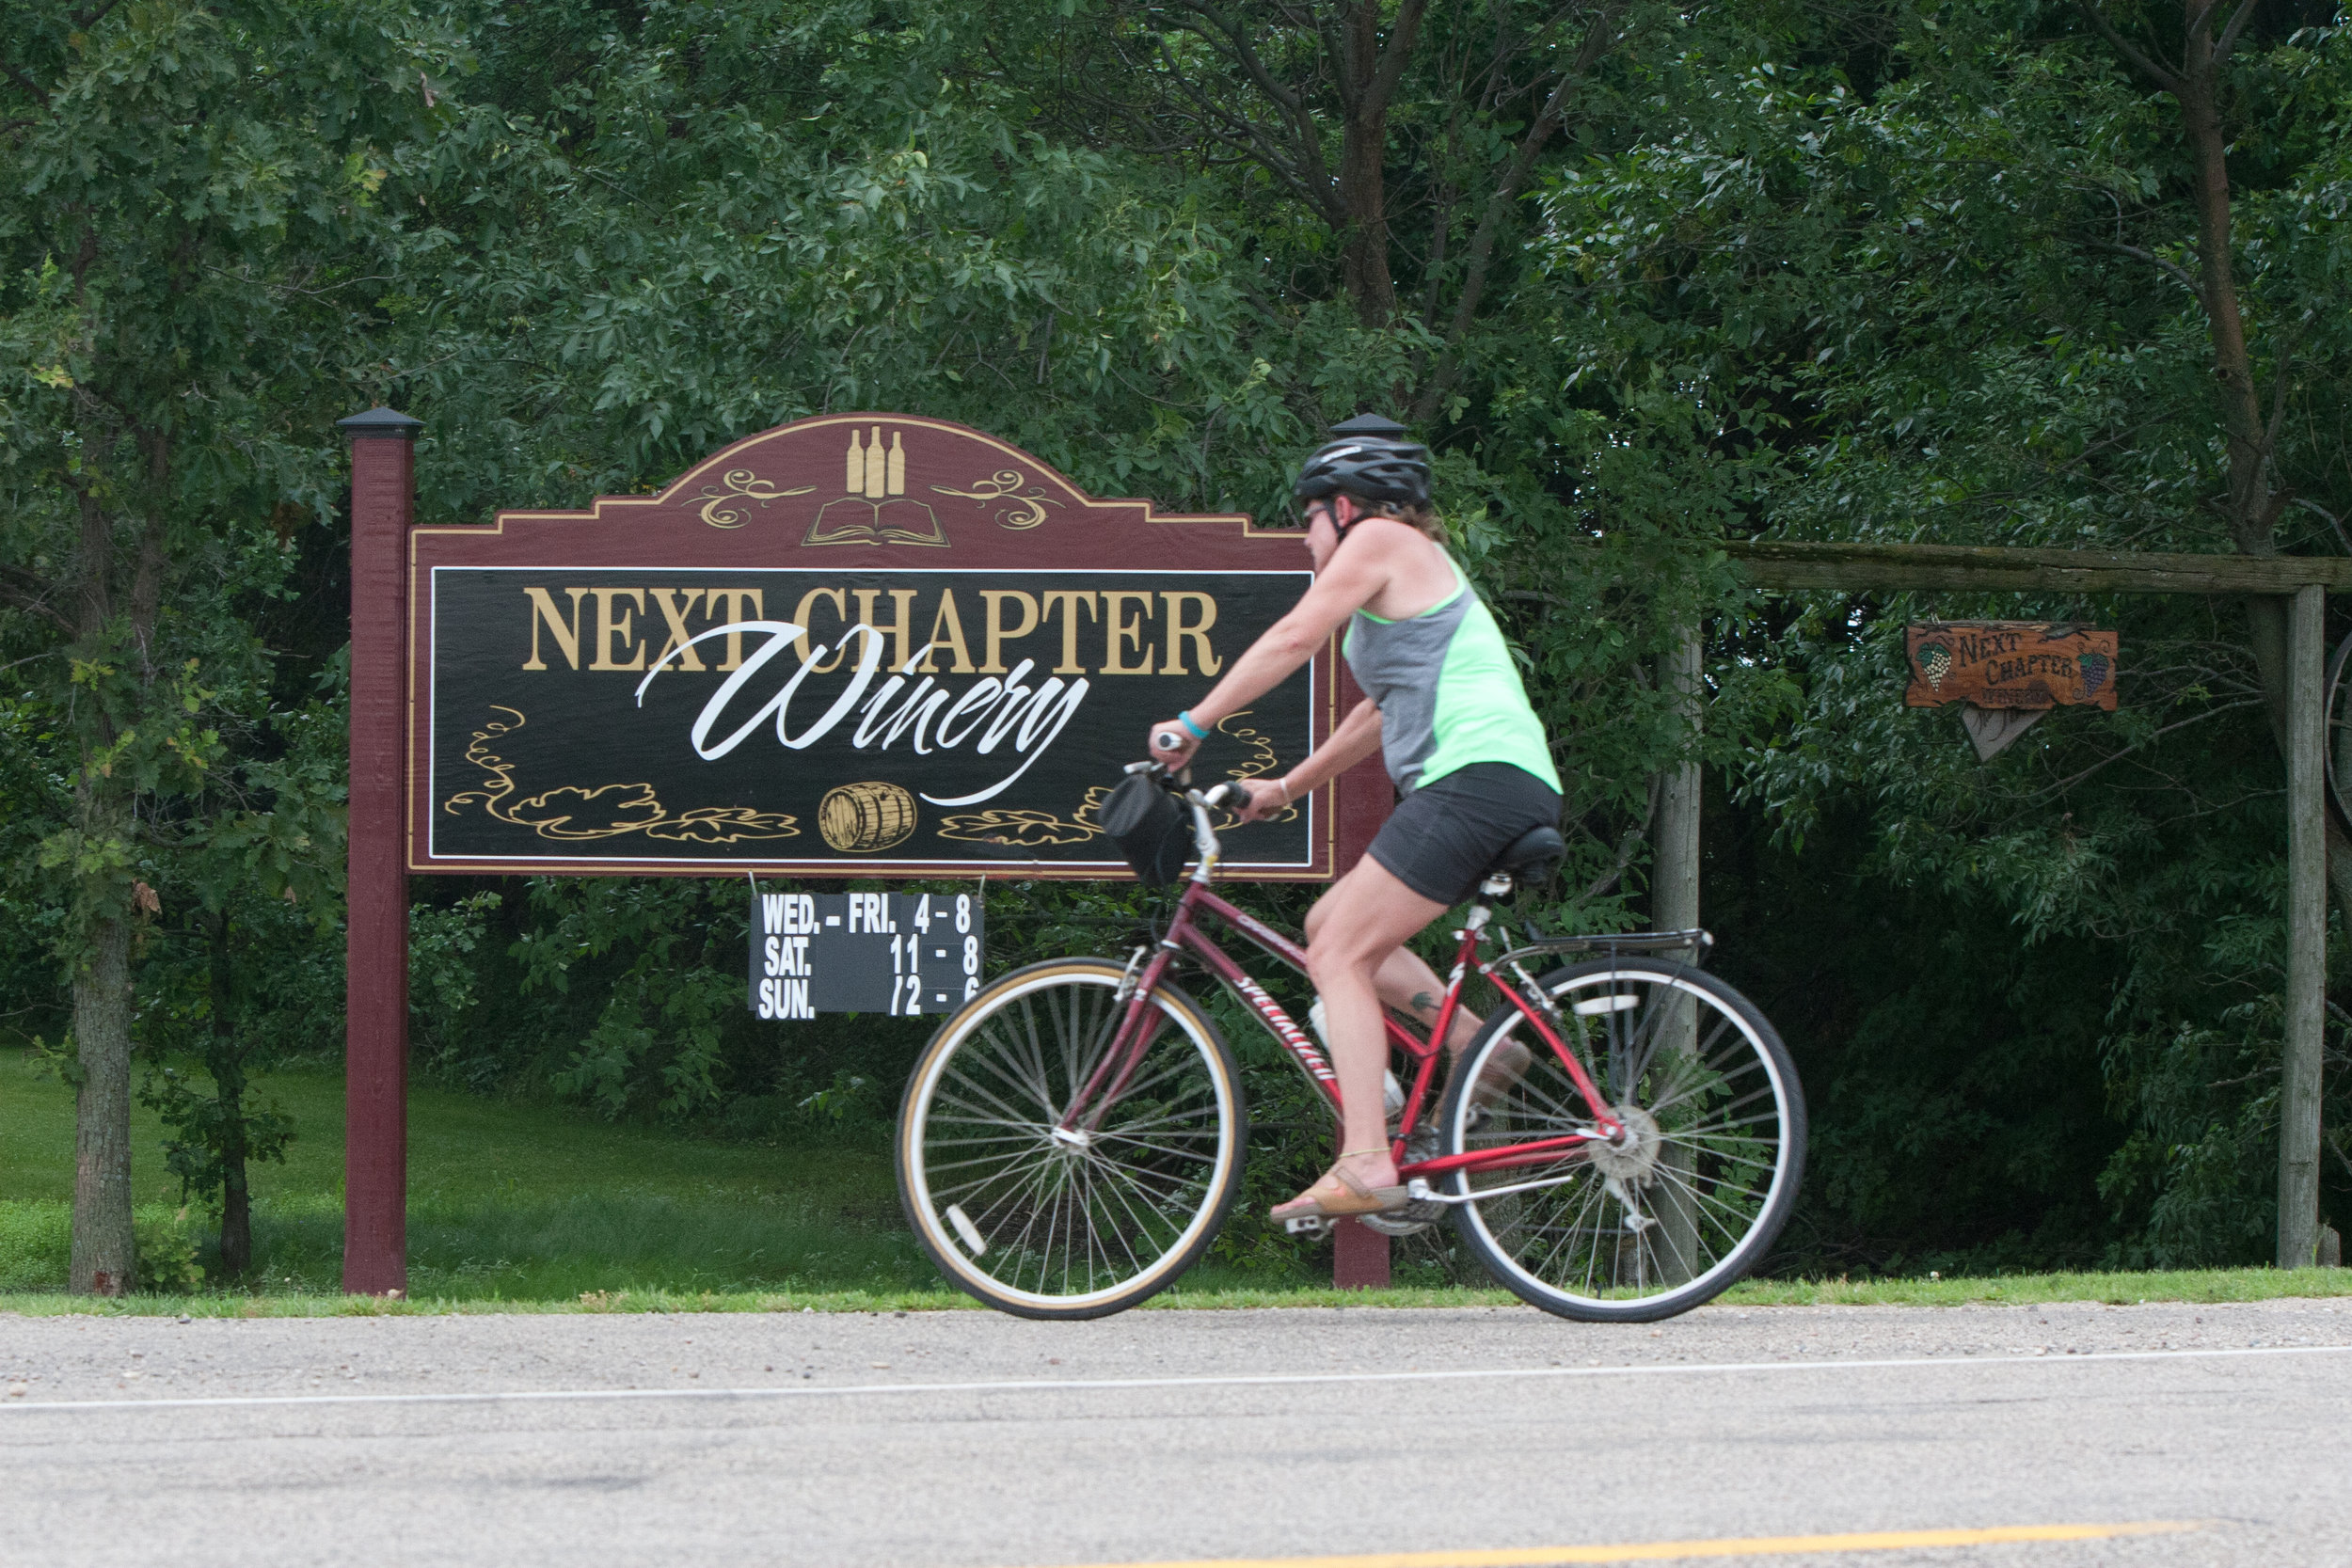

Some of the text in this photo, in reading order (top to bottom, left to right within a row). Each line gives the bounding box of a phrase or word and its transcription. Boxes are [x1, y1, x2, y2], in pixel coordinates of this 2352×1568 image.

[522, 587, 1223, 676] NEXT CHAPTER
[1959, 633, 2022, 668] NEXT
[1985, 655, 2073, 686] CHAPTER
[634, 620, 1089, 806] Winery
[762, 894, 820, 934] WED.
[849, 893, 896, 933] FRI.
[914, 893, 930, 935] 4
[955, 893, 972, 934] 8
[763, 935, 812, 976] SAT.
[890, 932, 918, 974] 11
[962, 935, 978, 975] 8
[758, 978, 816, 1019] SUN.
